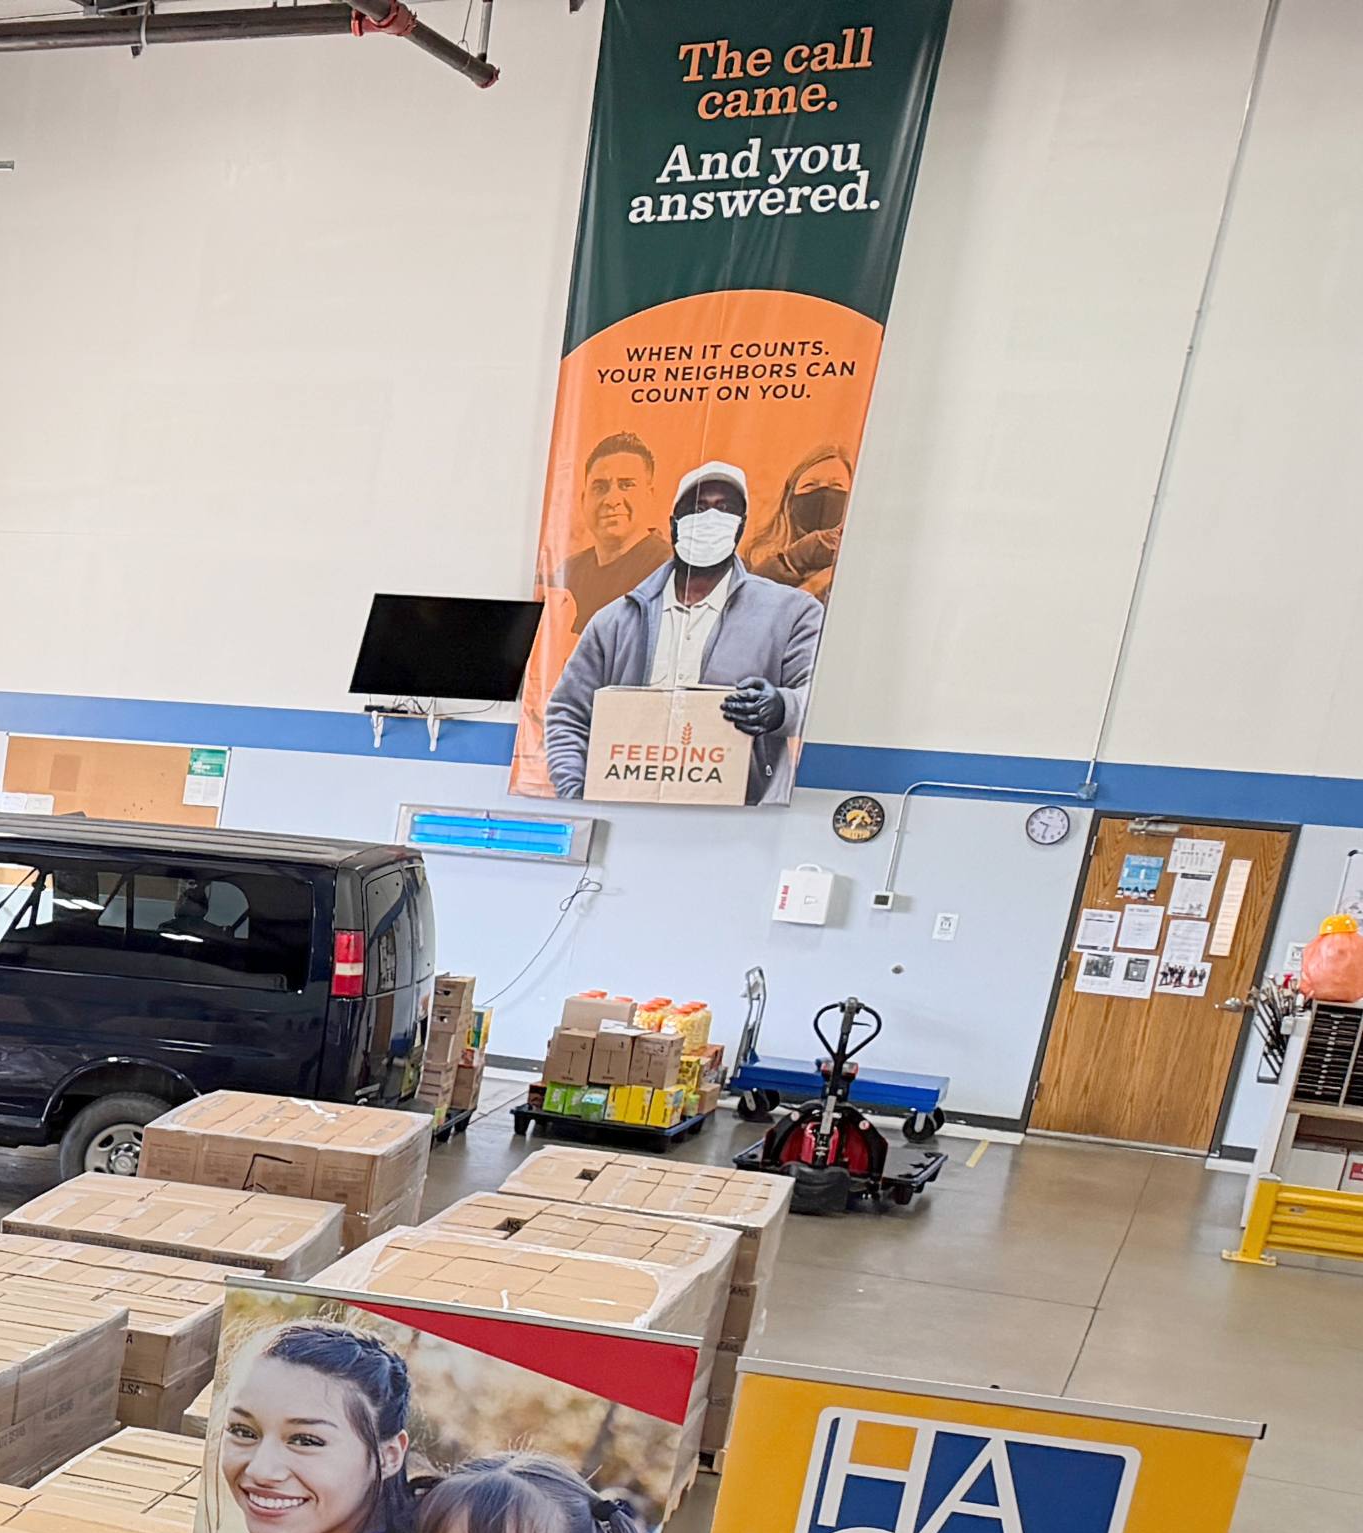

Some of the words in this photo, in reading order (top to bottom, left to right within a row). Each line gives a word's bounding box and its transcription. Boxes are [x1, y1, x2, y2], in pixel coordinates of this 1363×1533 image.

[678, 40, 771, 82] The
[783, 27, 873, 74] call
[697, 80, 839, 120] came.
[655, 138, 761, 184] And
[768, 141, 862, 185] you
[628, 170, 881, 224] answered.
[626, 345, 693, 363] WHEN
[701, 343, 723, 361] IT
[597, 366, 656, 384] YOUR
[664, 362, 797, 383] NEIGHBORS
[806, 360, 856, 377] CAN
[631, 386, 708, 403] COUNT
[716, 385, 749, 401] ON
[759, 382, 812, 400] YOU.
[609, 743, 725, 768] FEEDING
[604, 764, 723, 784] AMERICA
